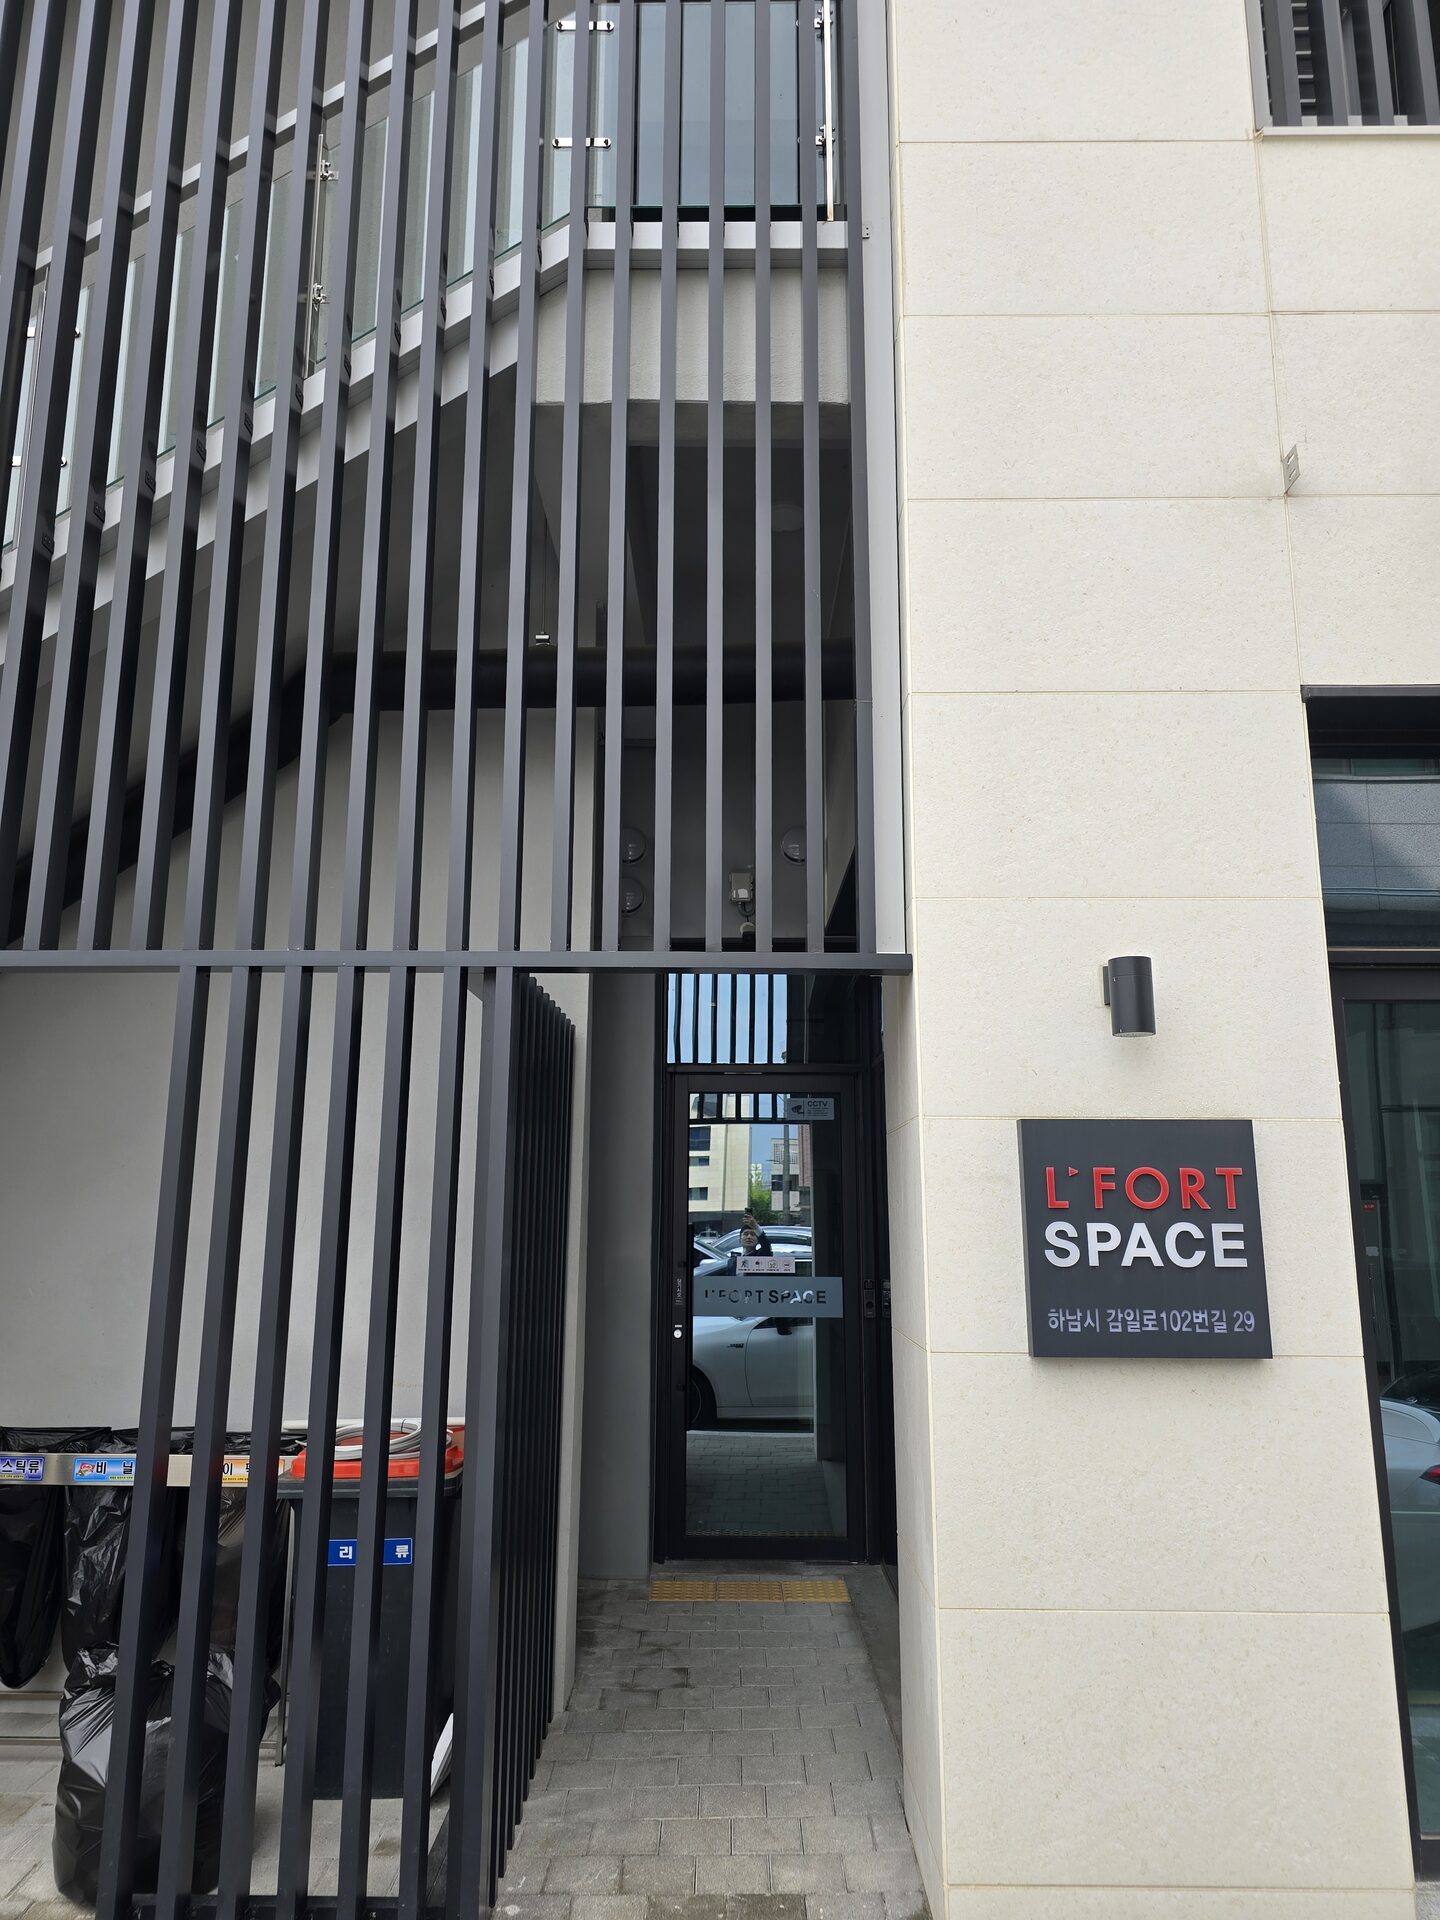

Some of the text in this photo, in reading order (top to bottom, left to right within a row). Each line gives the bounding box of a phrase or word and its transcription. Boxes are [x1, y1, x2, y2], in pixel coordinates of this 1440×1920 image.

[1044, 1221, 1248, 1268] SPACE
[768, 1289, 827, 1304] SPACE
[1048, 1308, 1255, 1334] 하남시 감일로102번길 29
